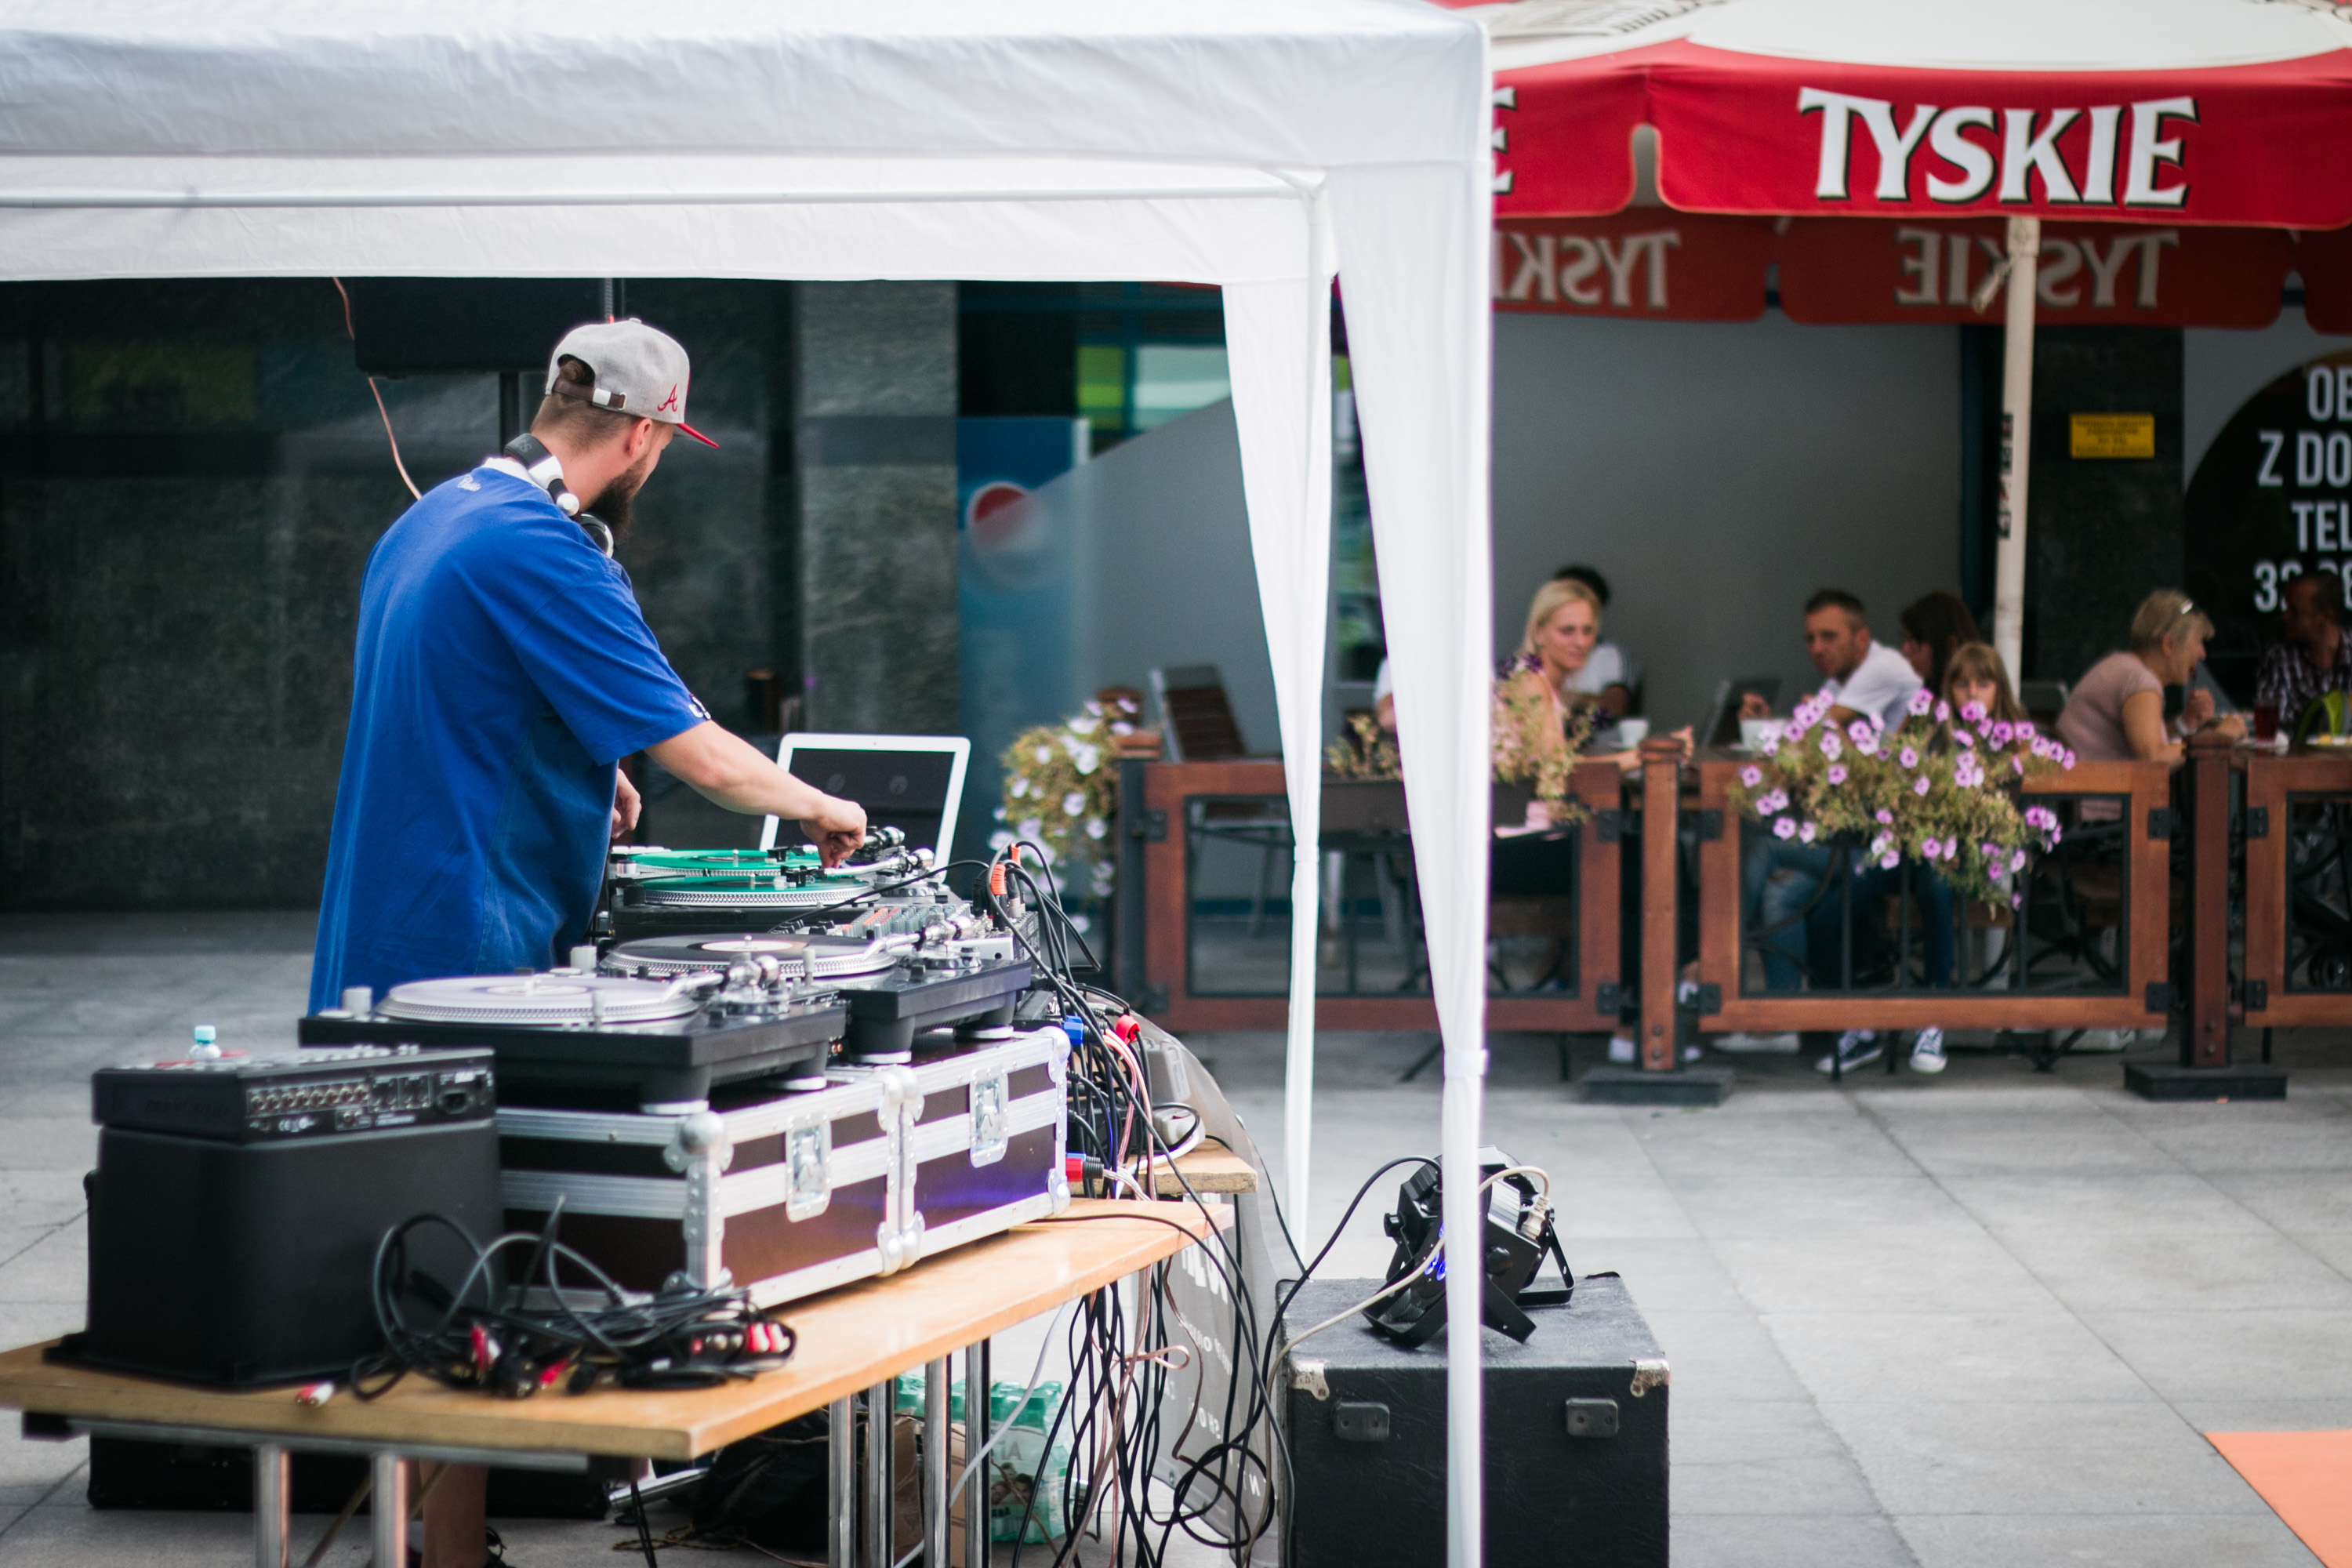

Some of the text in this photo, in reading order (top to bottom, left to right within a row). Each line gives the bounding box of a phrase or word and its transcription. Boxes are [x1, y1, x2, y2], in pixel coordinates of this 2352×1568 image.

[1796, 85, 2200, 209] TYSKIE
[657, 383, 678, 412] A
[2257, 430, 2284, 487] Z
